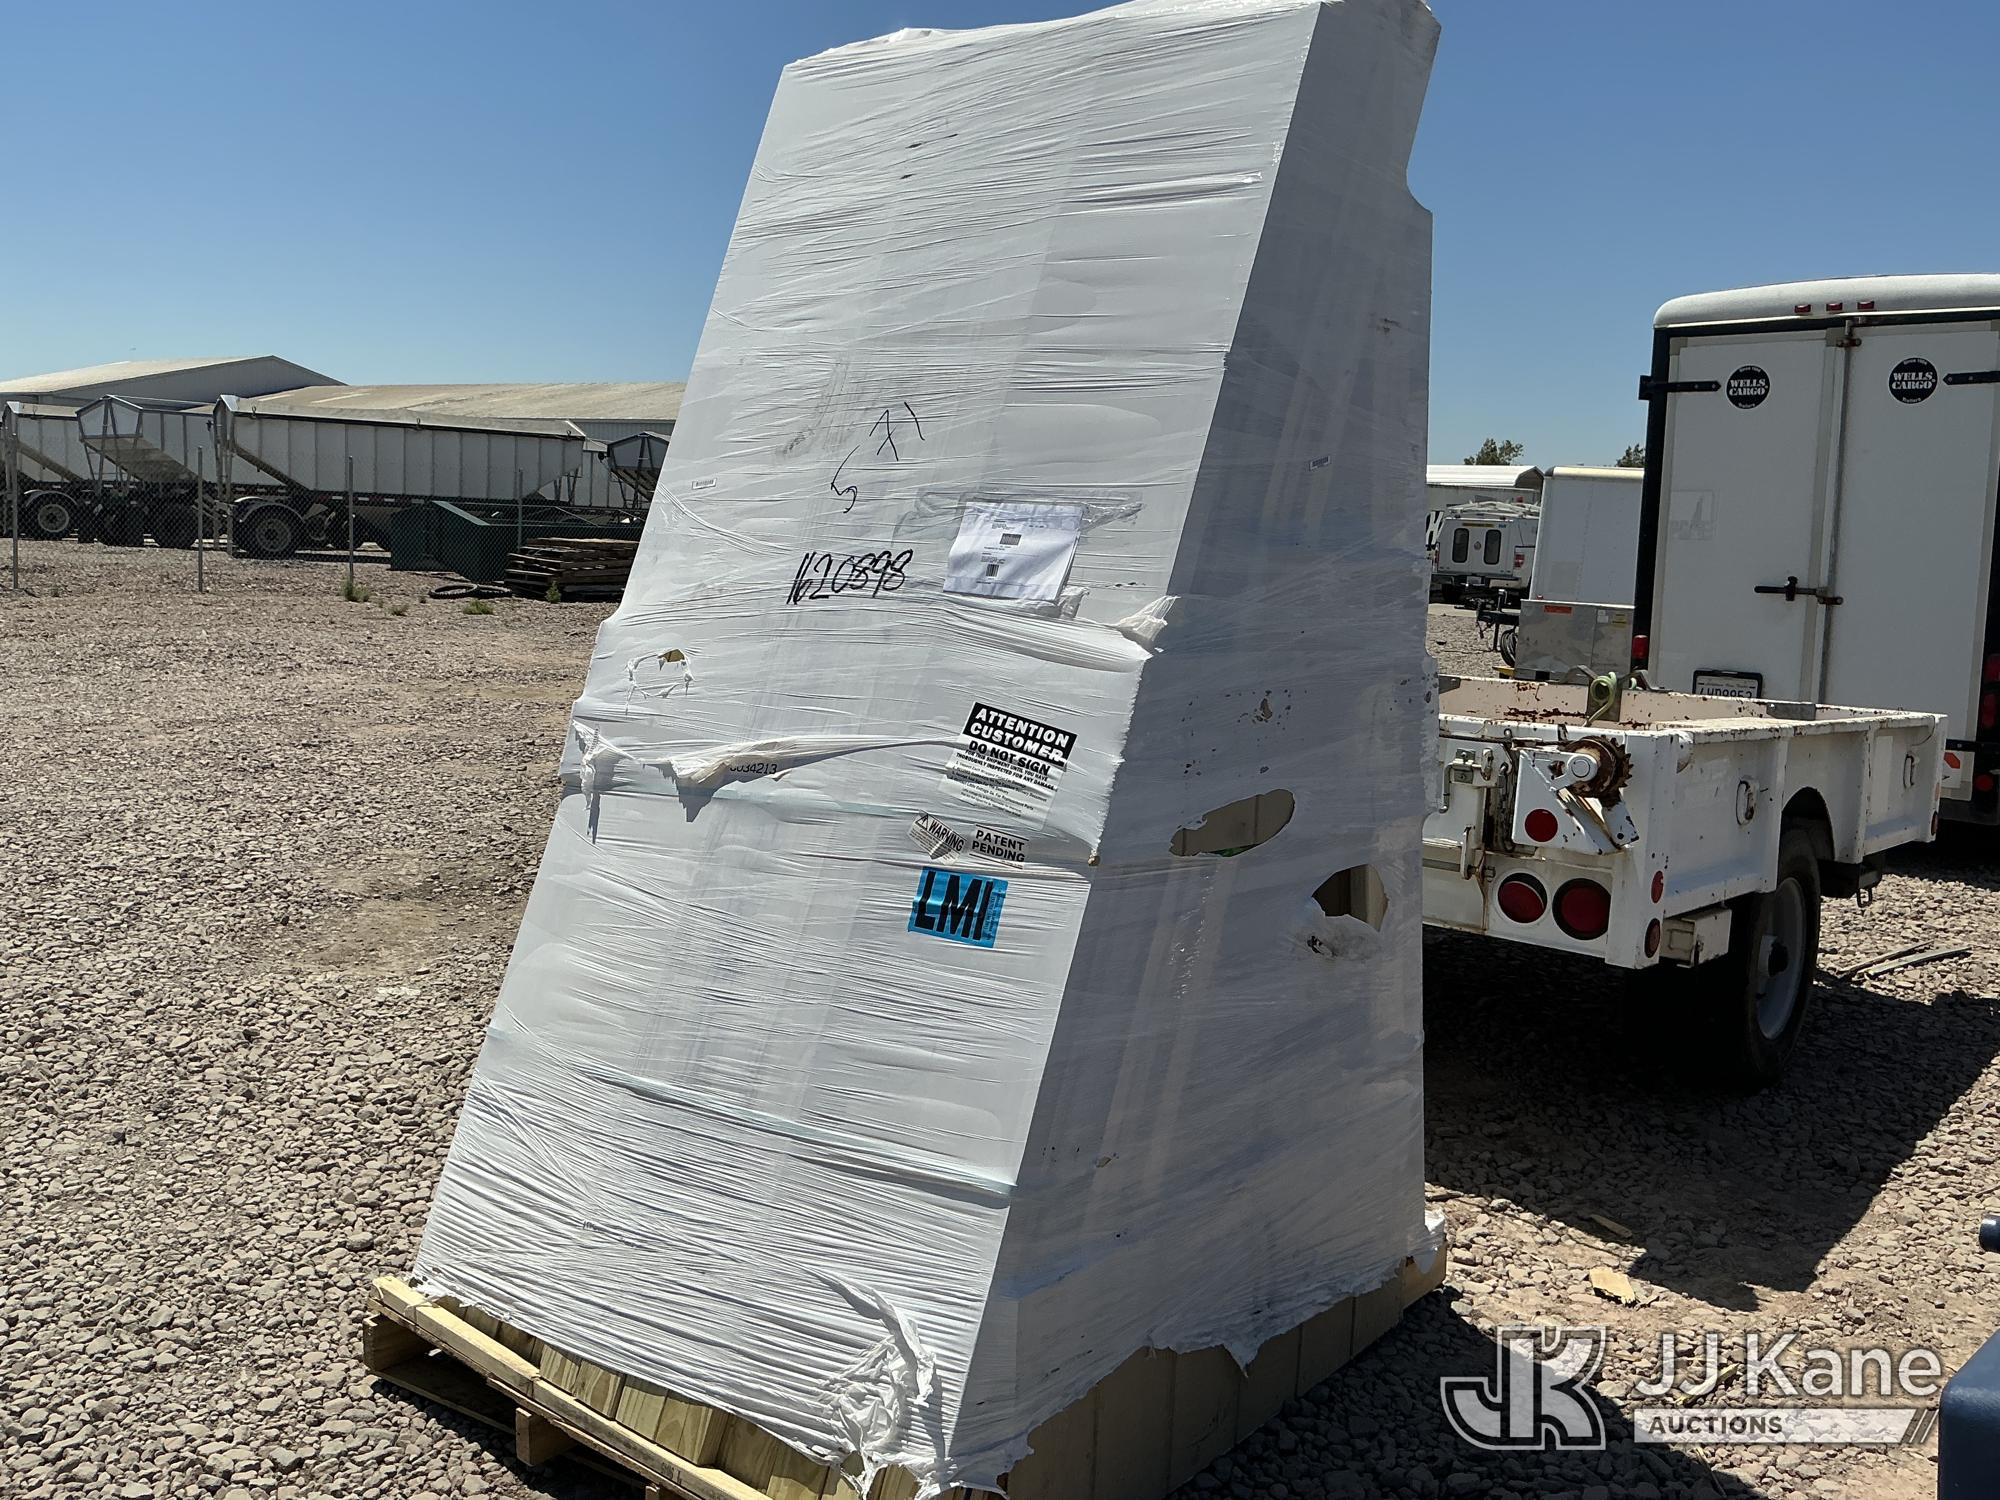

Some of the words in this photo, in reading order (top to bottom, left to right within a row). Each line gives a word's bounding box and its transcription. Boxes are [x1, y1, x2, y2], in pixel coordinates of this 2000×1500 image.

[1730, 378, 1766, 388] WELLS
[1892, 380, 1933, 390] CARGO
[1893, 372, 1934, 381] WELLS
[1729, 387, 1766, 396] CARGO
[786, 548, 914, 606] 1620898
[975, 707, 1069, 747] ATTENTION
[968, 721, 1064, 763] CUSTOMER
[956, 752, 986, 766] THOROUGHLY
[986, 762, 1012, 775] INSPECTED
[1012, 771, 1022, 779] FOR
[968, 739, 988, 754] DO
[989, 746, 1016, 764] NOT
[1016, 755, 1050, 776] SIGN
[986, 756, 1010, 768] SHIPMENT
[1010, 764, 1024, 773] UNTIL
[1034, 773, 1048, 781] HAVE
[928, 820, 965, 852] WARNING
[976, 830, 1025, 851] PATENT
[972, 840, 1026, 862] PENDING
[915, 870, 994, 940] LMI
